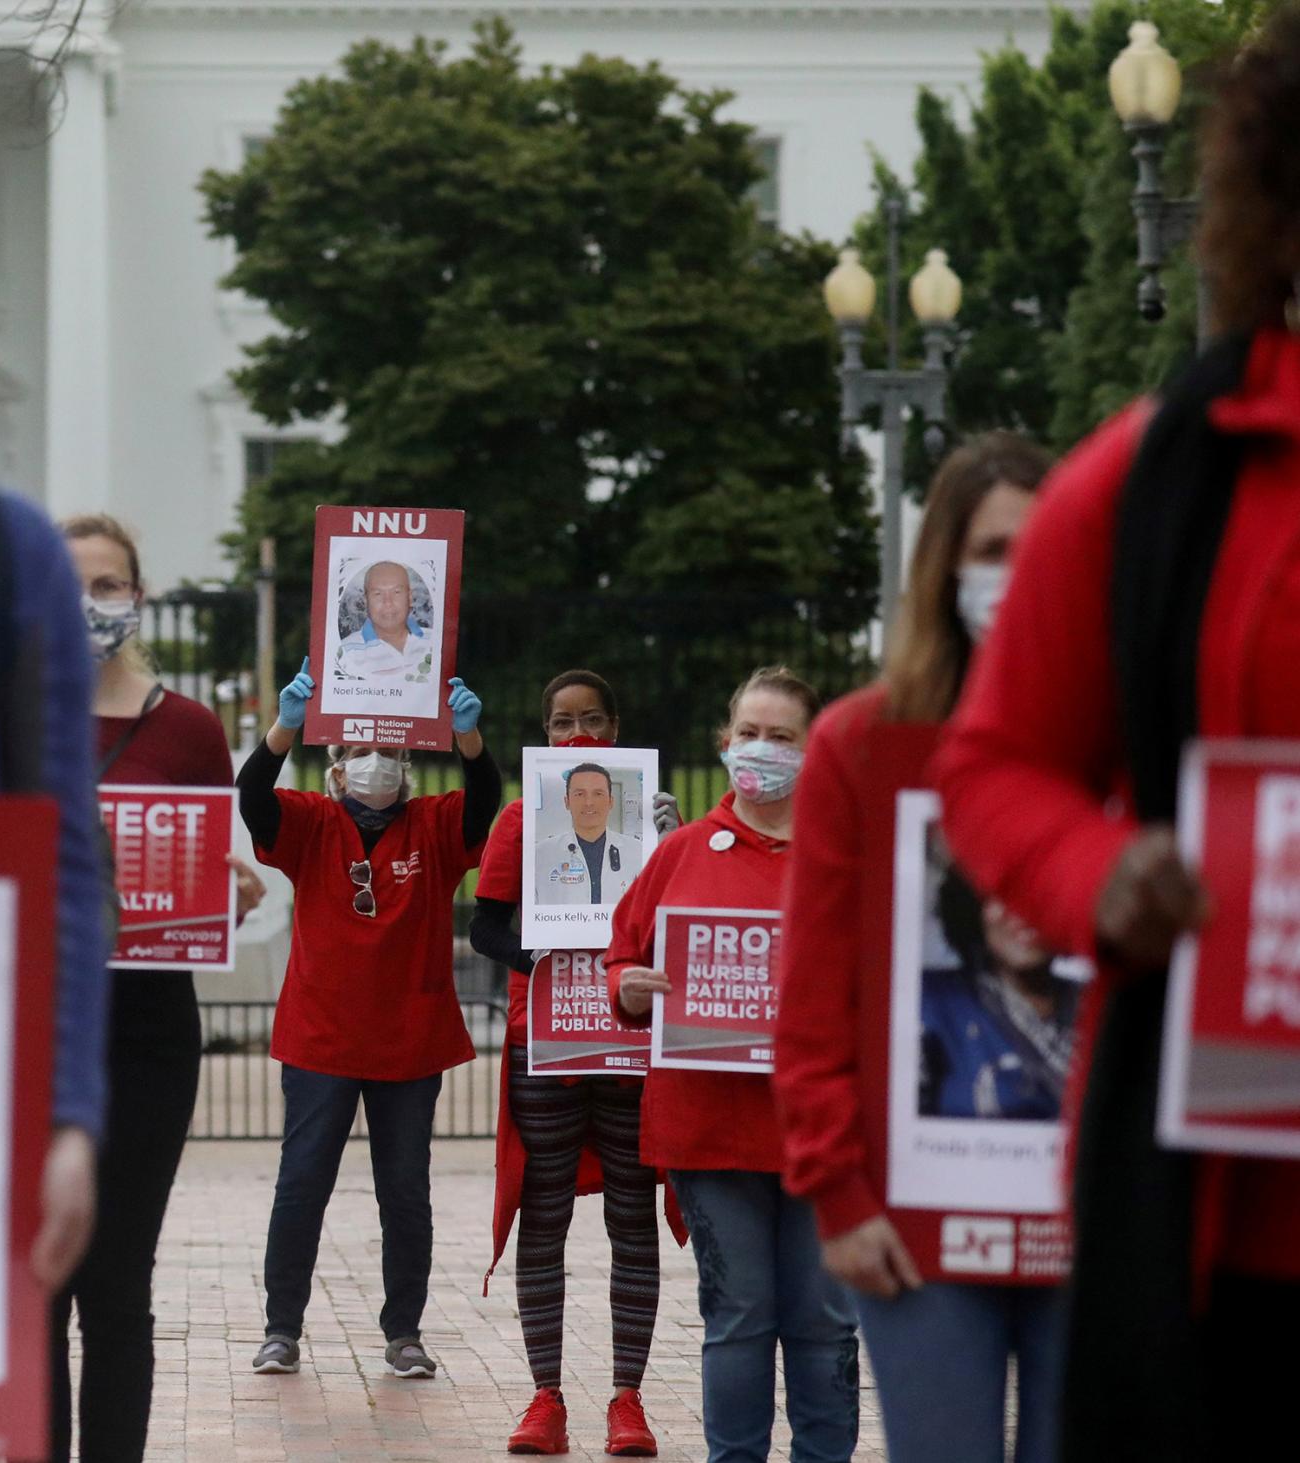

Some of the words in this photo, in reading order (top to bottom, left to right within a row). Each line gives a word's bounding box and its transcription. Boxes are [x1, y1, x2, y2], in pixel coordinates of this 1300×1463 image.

[352, 511, 427, 536] NNU
[333, 687, 354, 696] Noel
[355, 688, 388, 698] Sinkiat,
[389, 689, 403, 697] RN
[377, 720, 414, 729] National
[377, 728, 407, 736] Nurses
[376, 735, 406, 744] United
[534, 913, 562, 922] Kious
[564, 912, 591, 923] Kelly,
[594, 912, 609, 921] RN
[687, 964, 769, 982] NURSES
[685, 1000, 760, 1019] PUBLIC
[551, 1017, 612, 1032] PUBLIC
